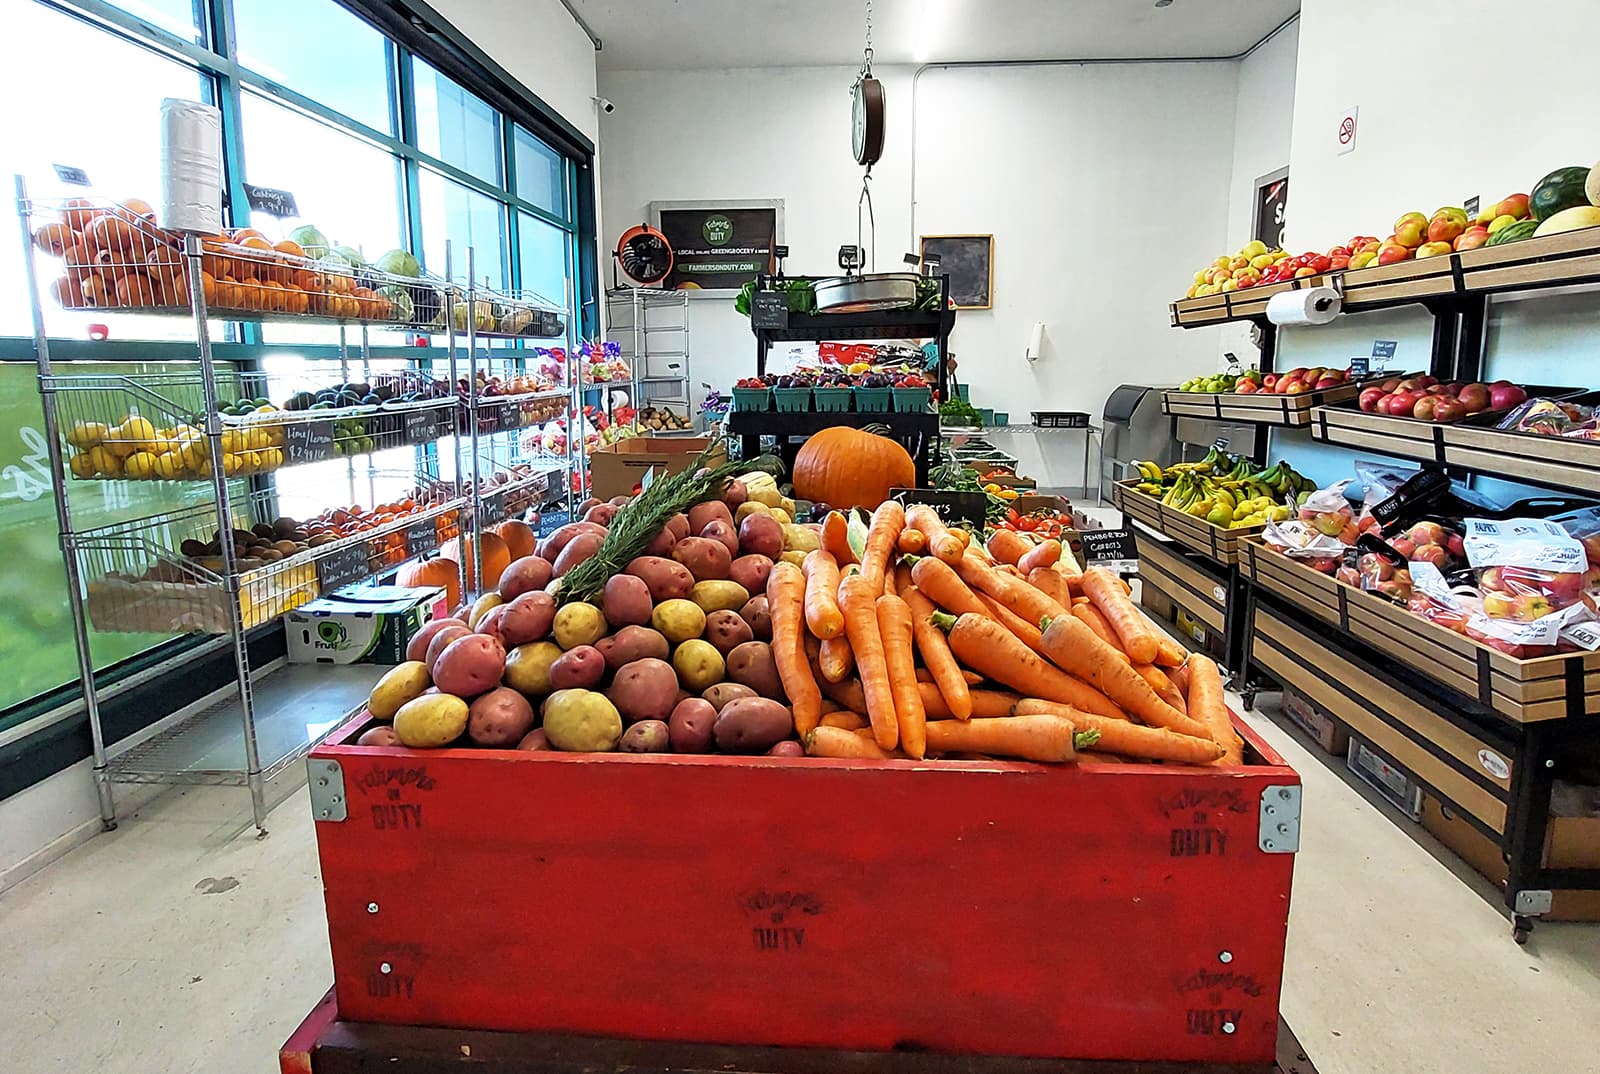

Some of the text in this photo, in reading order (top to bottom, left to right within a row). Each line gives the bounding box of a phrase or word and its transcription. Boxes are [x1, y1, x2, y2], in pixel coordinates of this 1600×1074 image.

[710, 231, 725, 241] DUTY
[688, 263, 754, 273] FARMERSONDUTY.COM
[1083, 531, 1129, 543] PEMBERTON
[371, 804, 422, 831] DUTY
[1170, 828, 1228, 857] DUTY
[752, 927, 805, 952] DUTY
